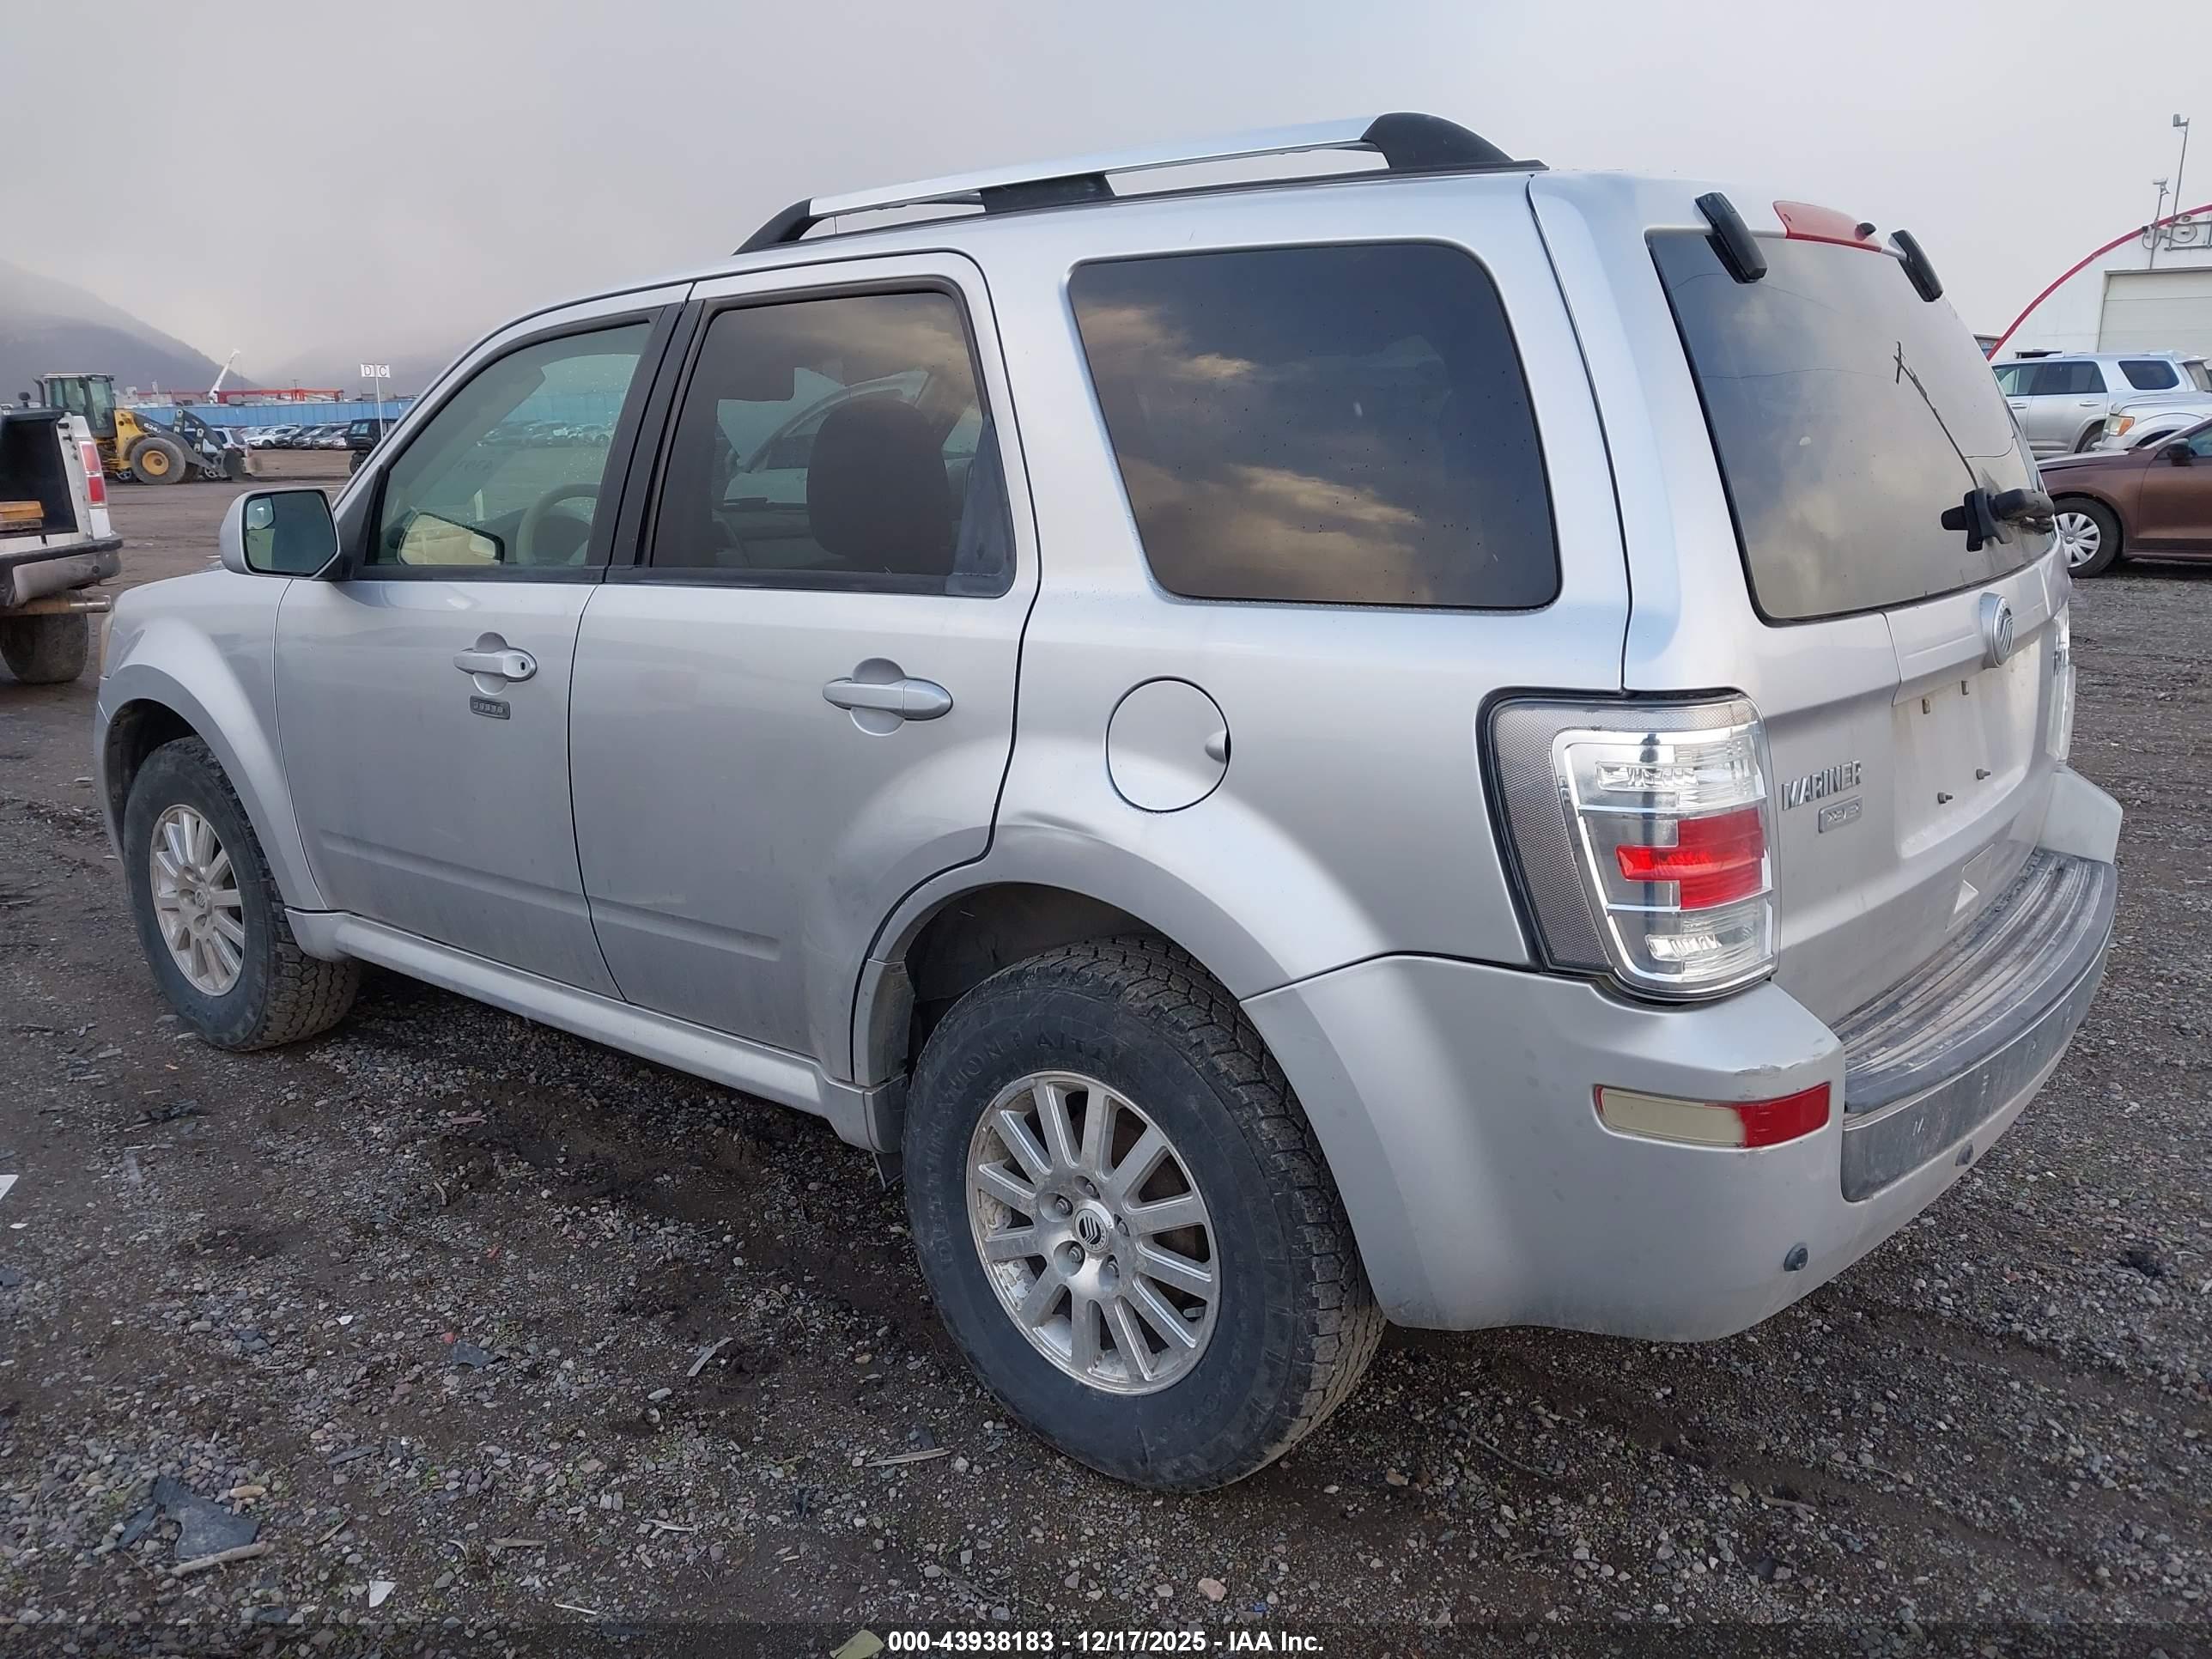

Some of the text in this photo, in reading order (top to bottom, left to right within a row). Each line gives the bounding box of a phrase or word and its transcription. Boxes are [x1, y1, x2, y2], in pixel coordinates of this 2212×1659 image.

[363, 365, 387, 377] D C
[1781, 760, 1862, 811] MARINER
